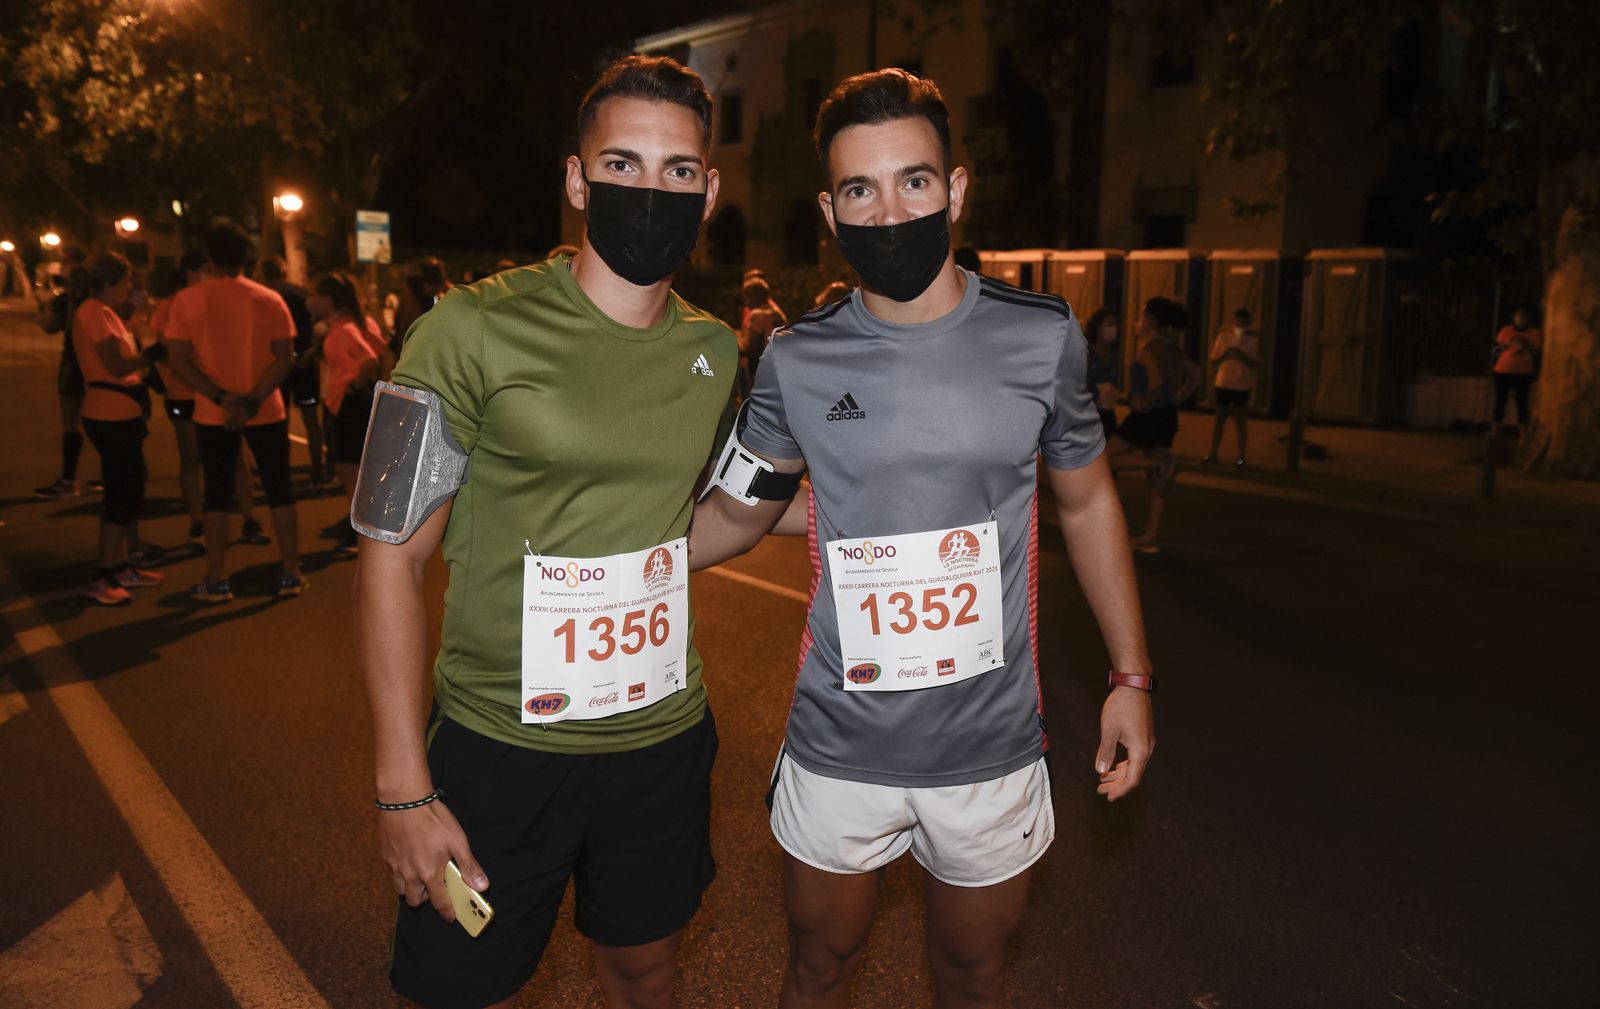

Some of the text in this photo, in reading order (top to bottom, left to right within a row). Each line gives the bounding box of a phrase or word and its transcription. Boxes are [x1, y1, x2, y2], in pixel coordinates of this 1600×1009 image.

[826, 409, 866, 421] adidas
[950, 557, 979, 565] NOCTURNA
[854, 582, 880, 590] CARRERA
[880, 577, 915, 588] NOCTURNA
[928, 571, 973, 584] GUADALQUIVIR
[973, 568, 985, 577] KH7
[985, 565, 998, 574] 2021
[549, 606, 581, 614] CARRERA
[582, 602, 618, 614] NOCTURNA
[618, 601, 630, 609] DEL
[631, 590, 667, 606] GUADALQUIVIR
[860, 582, 979, 636] 1352
[554, 602, 670, 664] 1356
[978, 647, 993, 658] ABC
[665, 668, 678, 680] ABC
